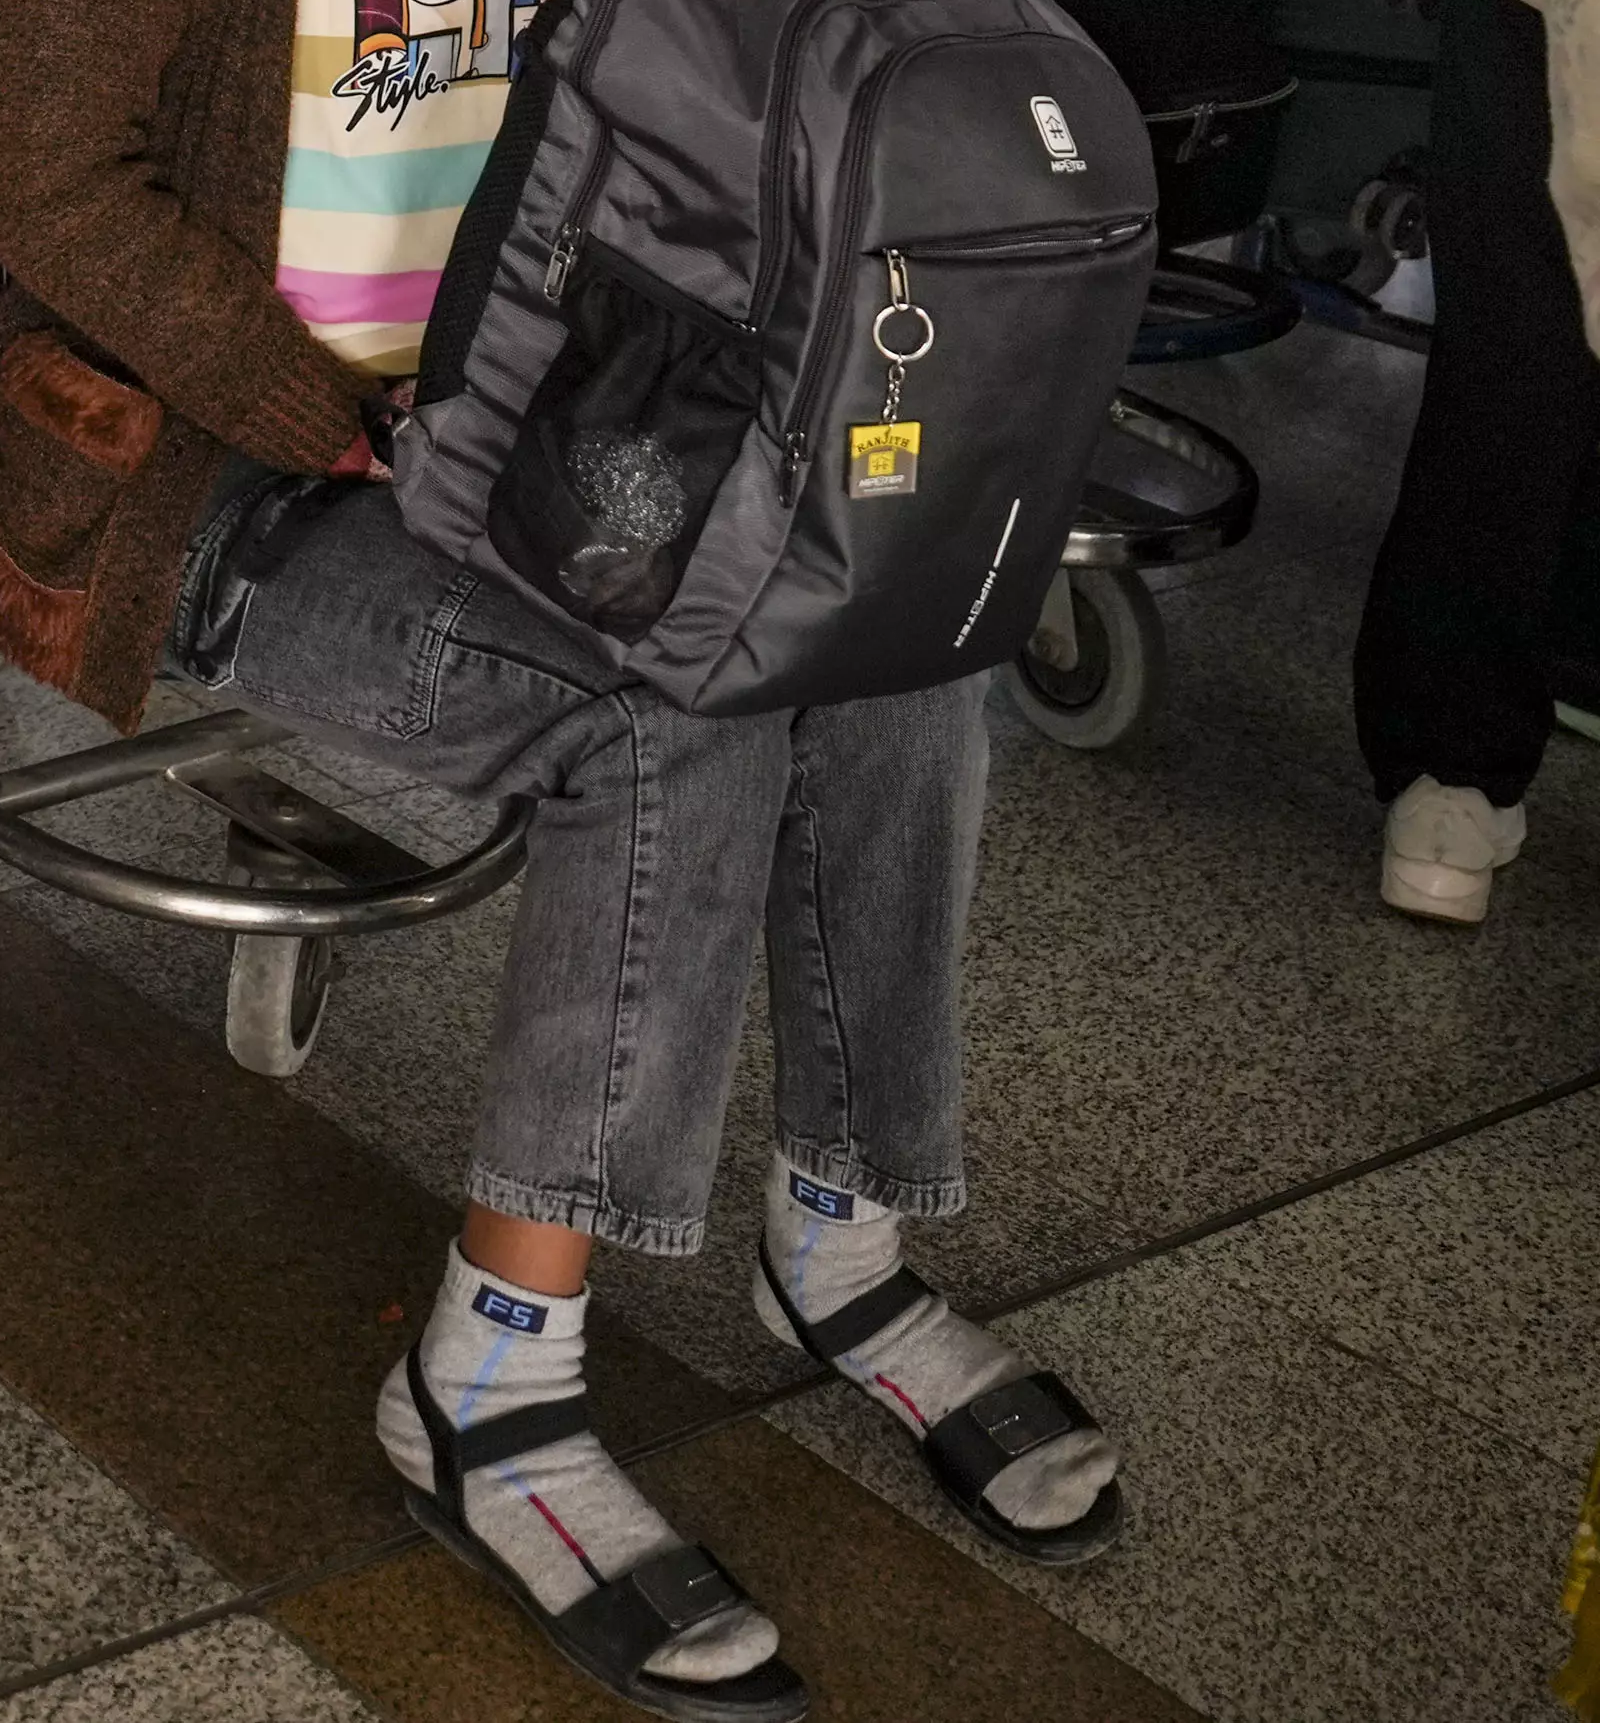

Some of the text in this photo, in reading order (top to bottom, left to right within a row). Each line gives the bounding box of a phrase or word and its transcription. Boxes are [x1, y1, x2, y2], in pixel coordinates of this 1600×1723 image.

[856, 426, 910, 453] RANJITH
[798, 1180, 837, 1214] FS
[484, 1293, 533, 1327] FS
